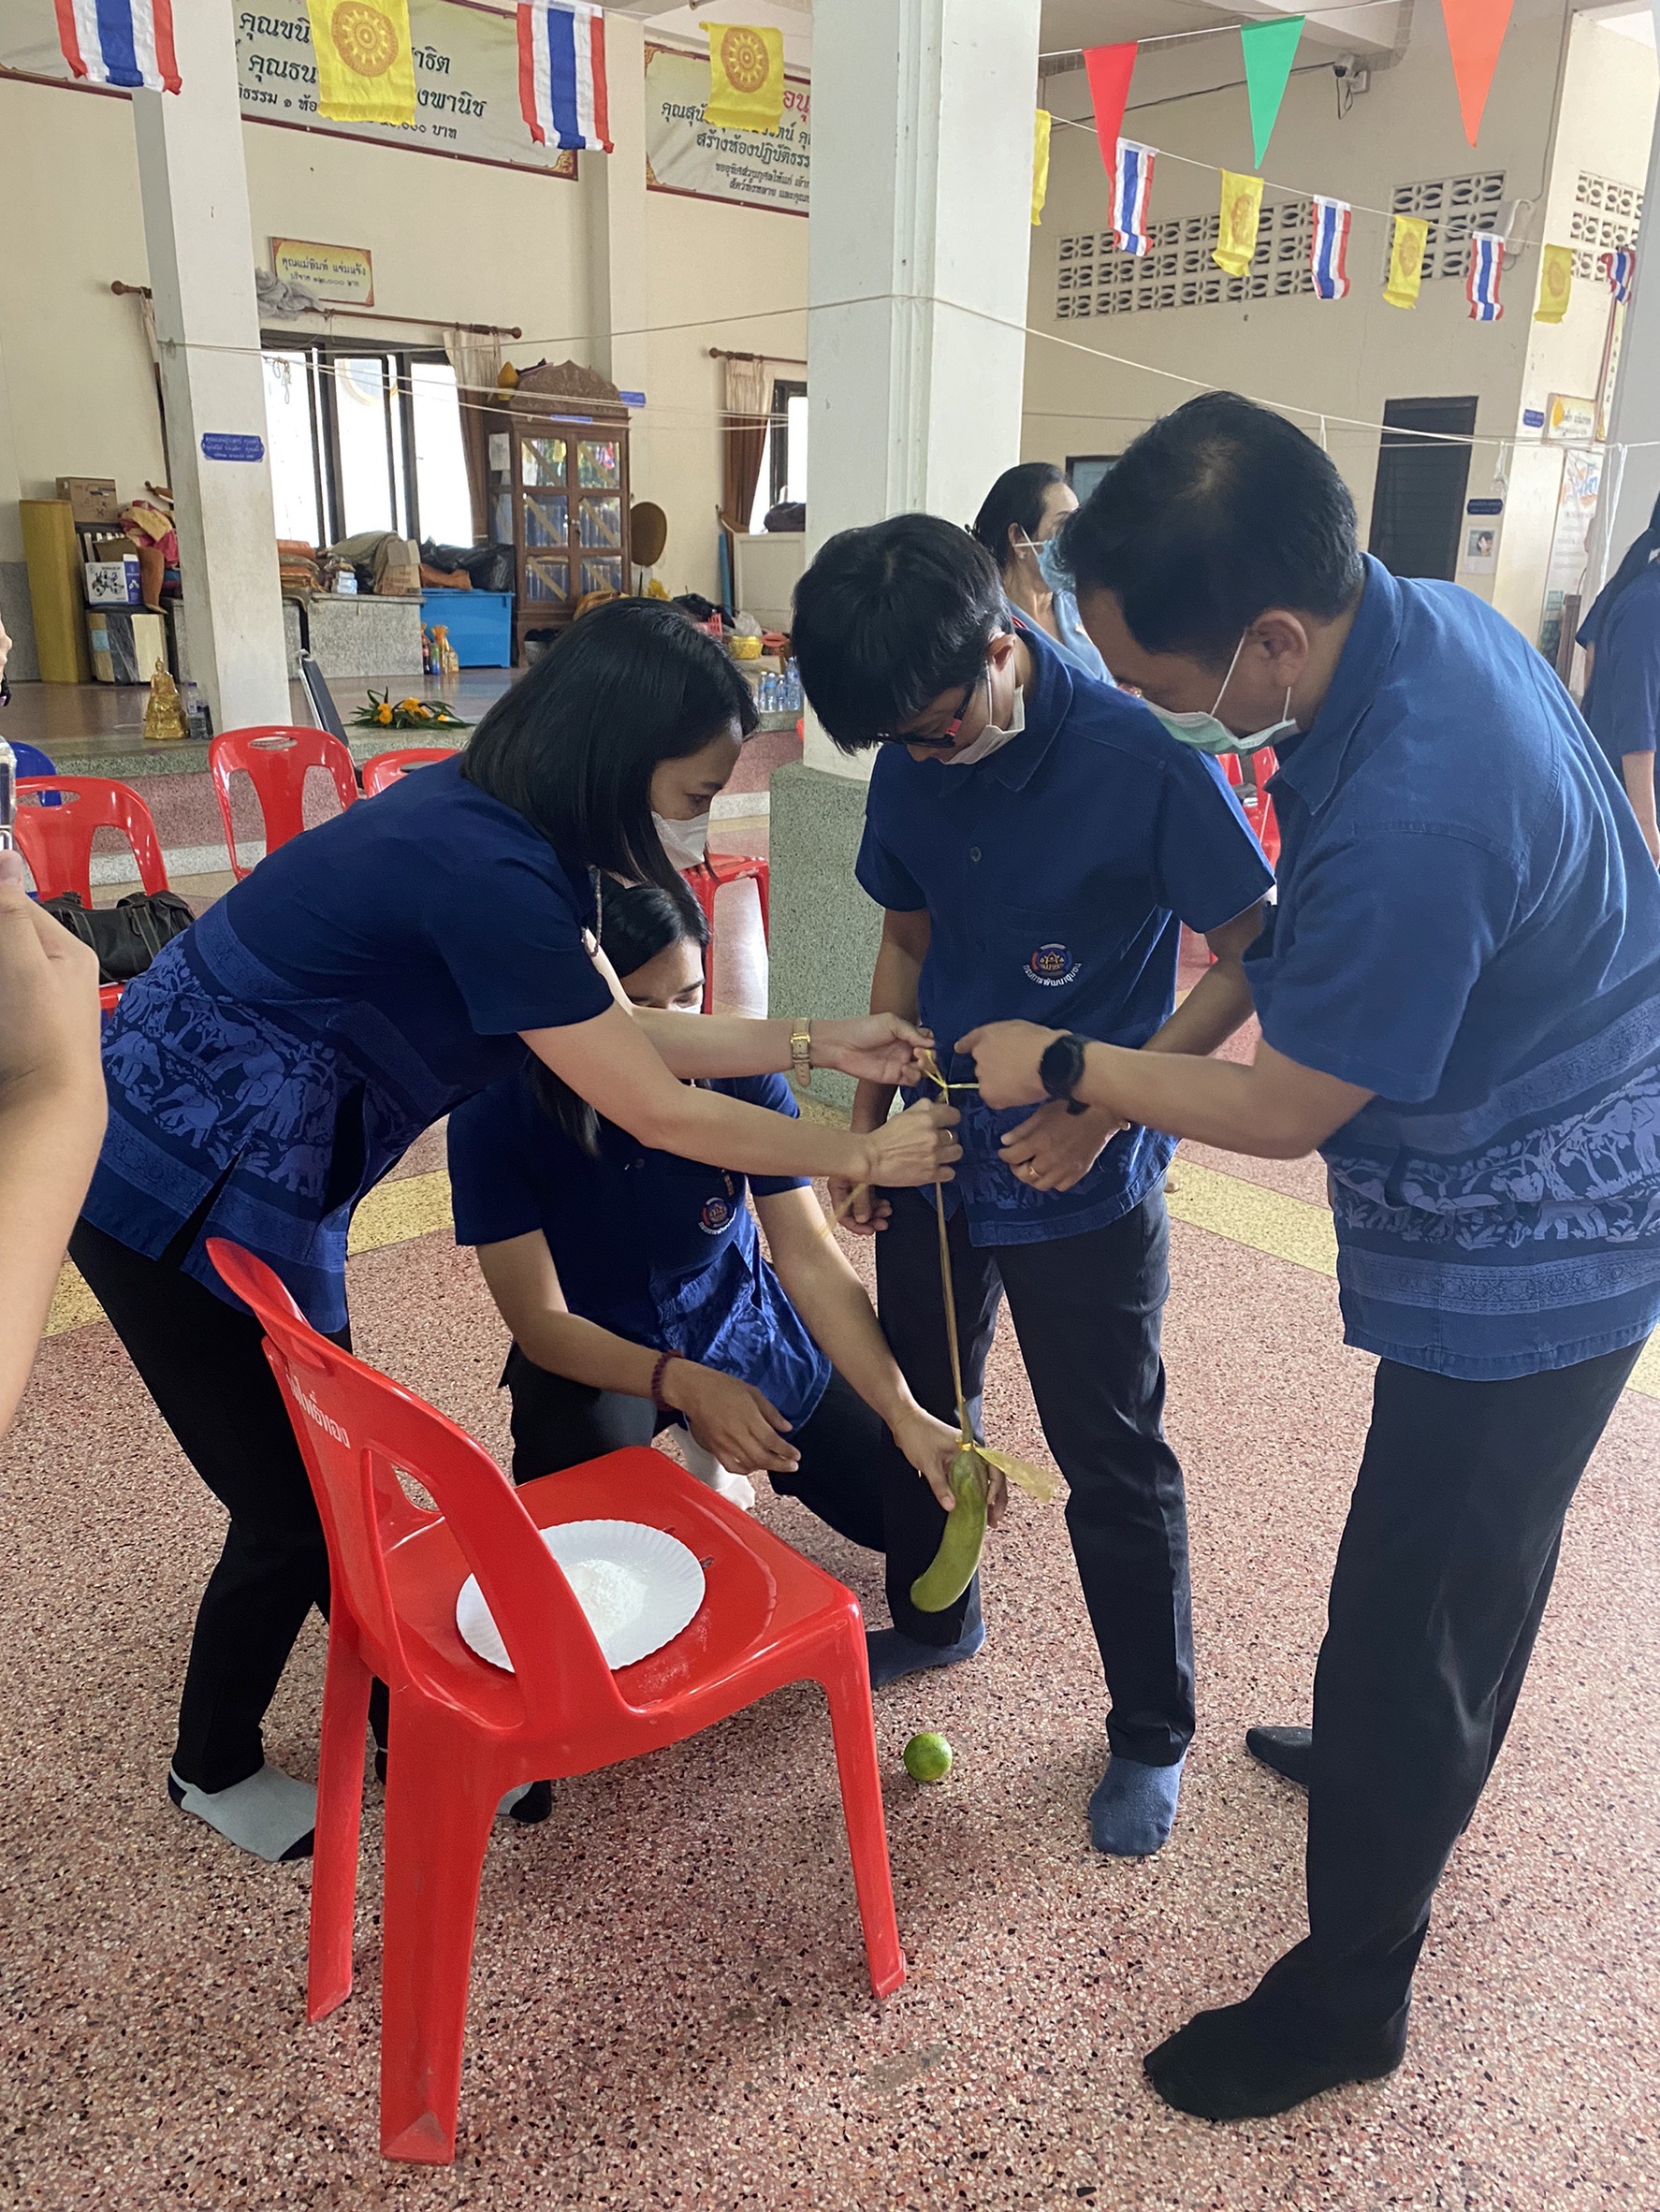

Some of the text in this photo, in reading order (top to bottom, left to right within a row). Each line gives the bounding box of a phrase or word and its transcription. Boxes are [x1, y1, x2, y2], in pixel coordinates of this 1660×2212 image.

[248, 54, 318, 83] คุณธน
[412, 46, 451, 74] าธิต
[299, 95, 318, 112] ห้อ
[432, 124, 458, 139] บาท
[662, 102, 709, 127] คุณสุนั
